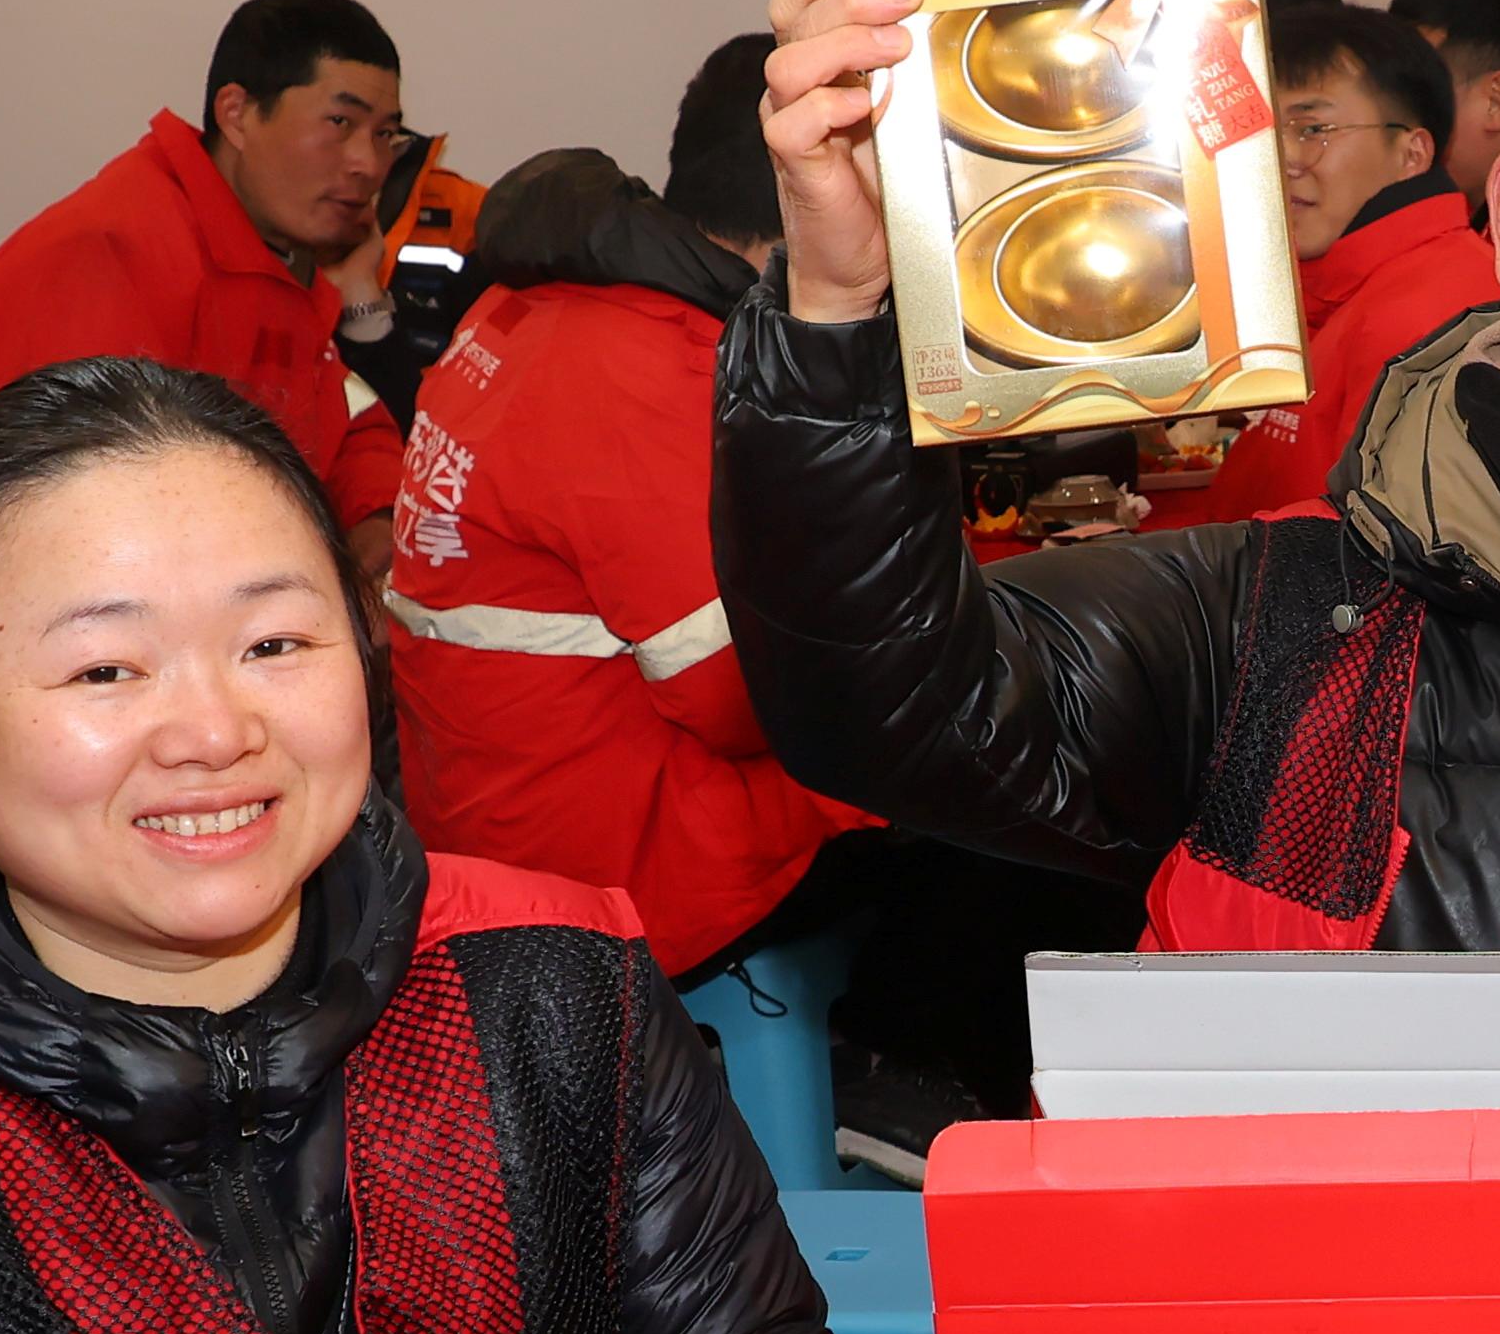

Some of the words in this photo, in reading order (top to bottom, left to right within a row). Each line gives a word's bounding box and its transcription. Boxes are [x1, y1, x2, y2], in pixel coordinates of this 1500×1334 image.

[1200, 59, 1228, 83] NIU
[1207, 74, 1238, 97] ZHA
[1214, 83, 1255, 111] TANG
